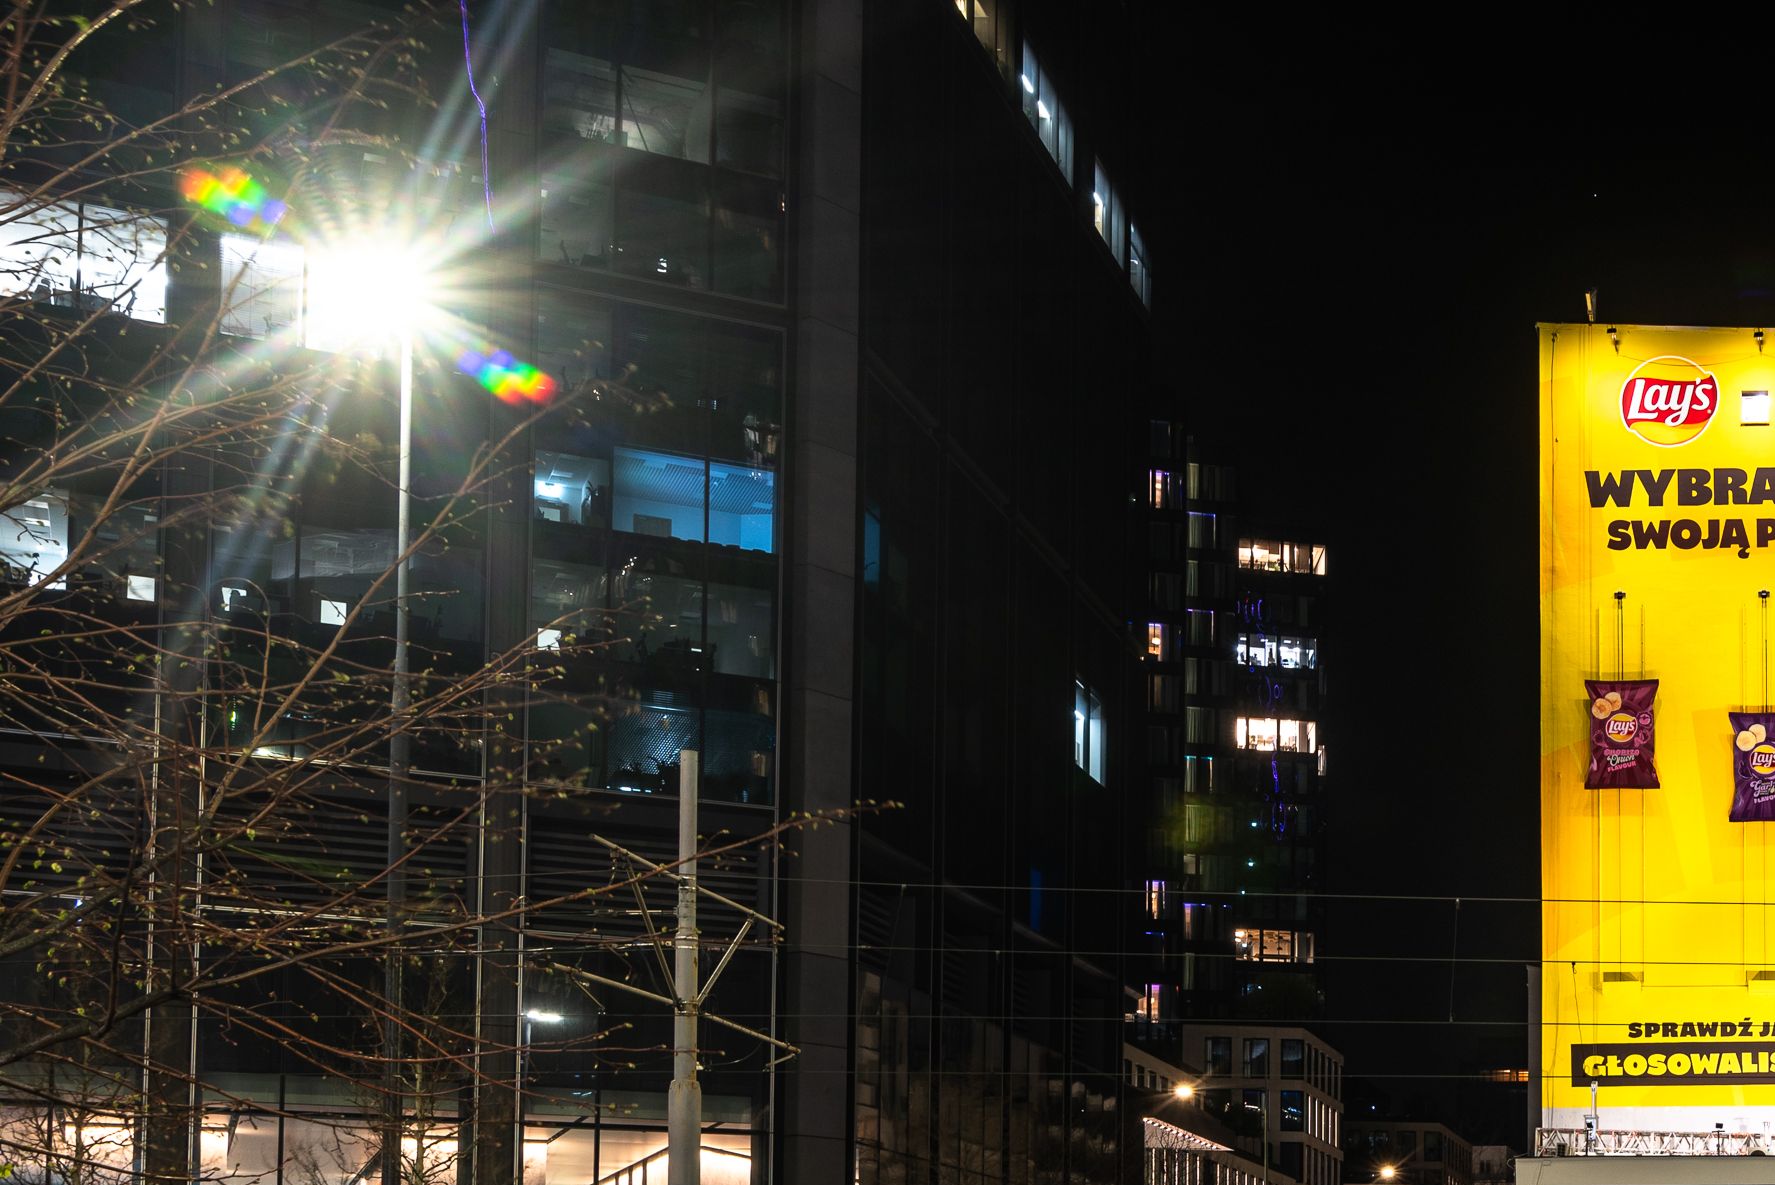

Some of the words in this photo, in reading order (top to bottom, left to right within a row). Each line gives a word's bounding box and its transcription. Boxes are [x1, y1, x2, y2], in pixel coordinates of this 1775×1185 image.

[1627, 377, 1713, 426] Lay's
[1607, 517, 1751, 559] SWOJĄ
[1628, 1017, 1753, 1038] SPRAWDŹ
